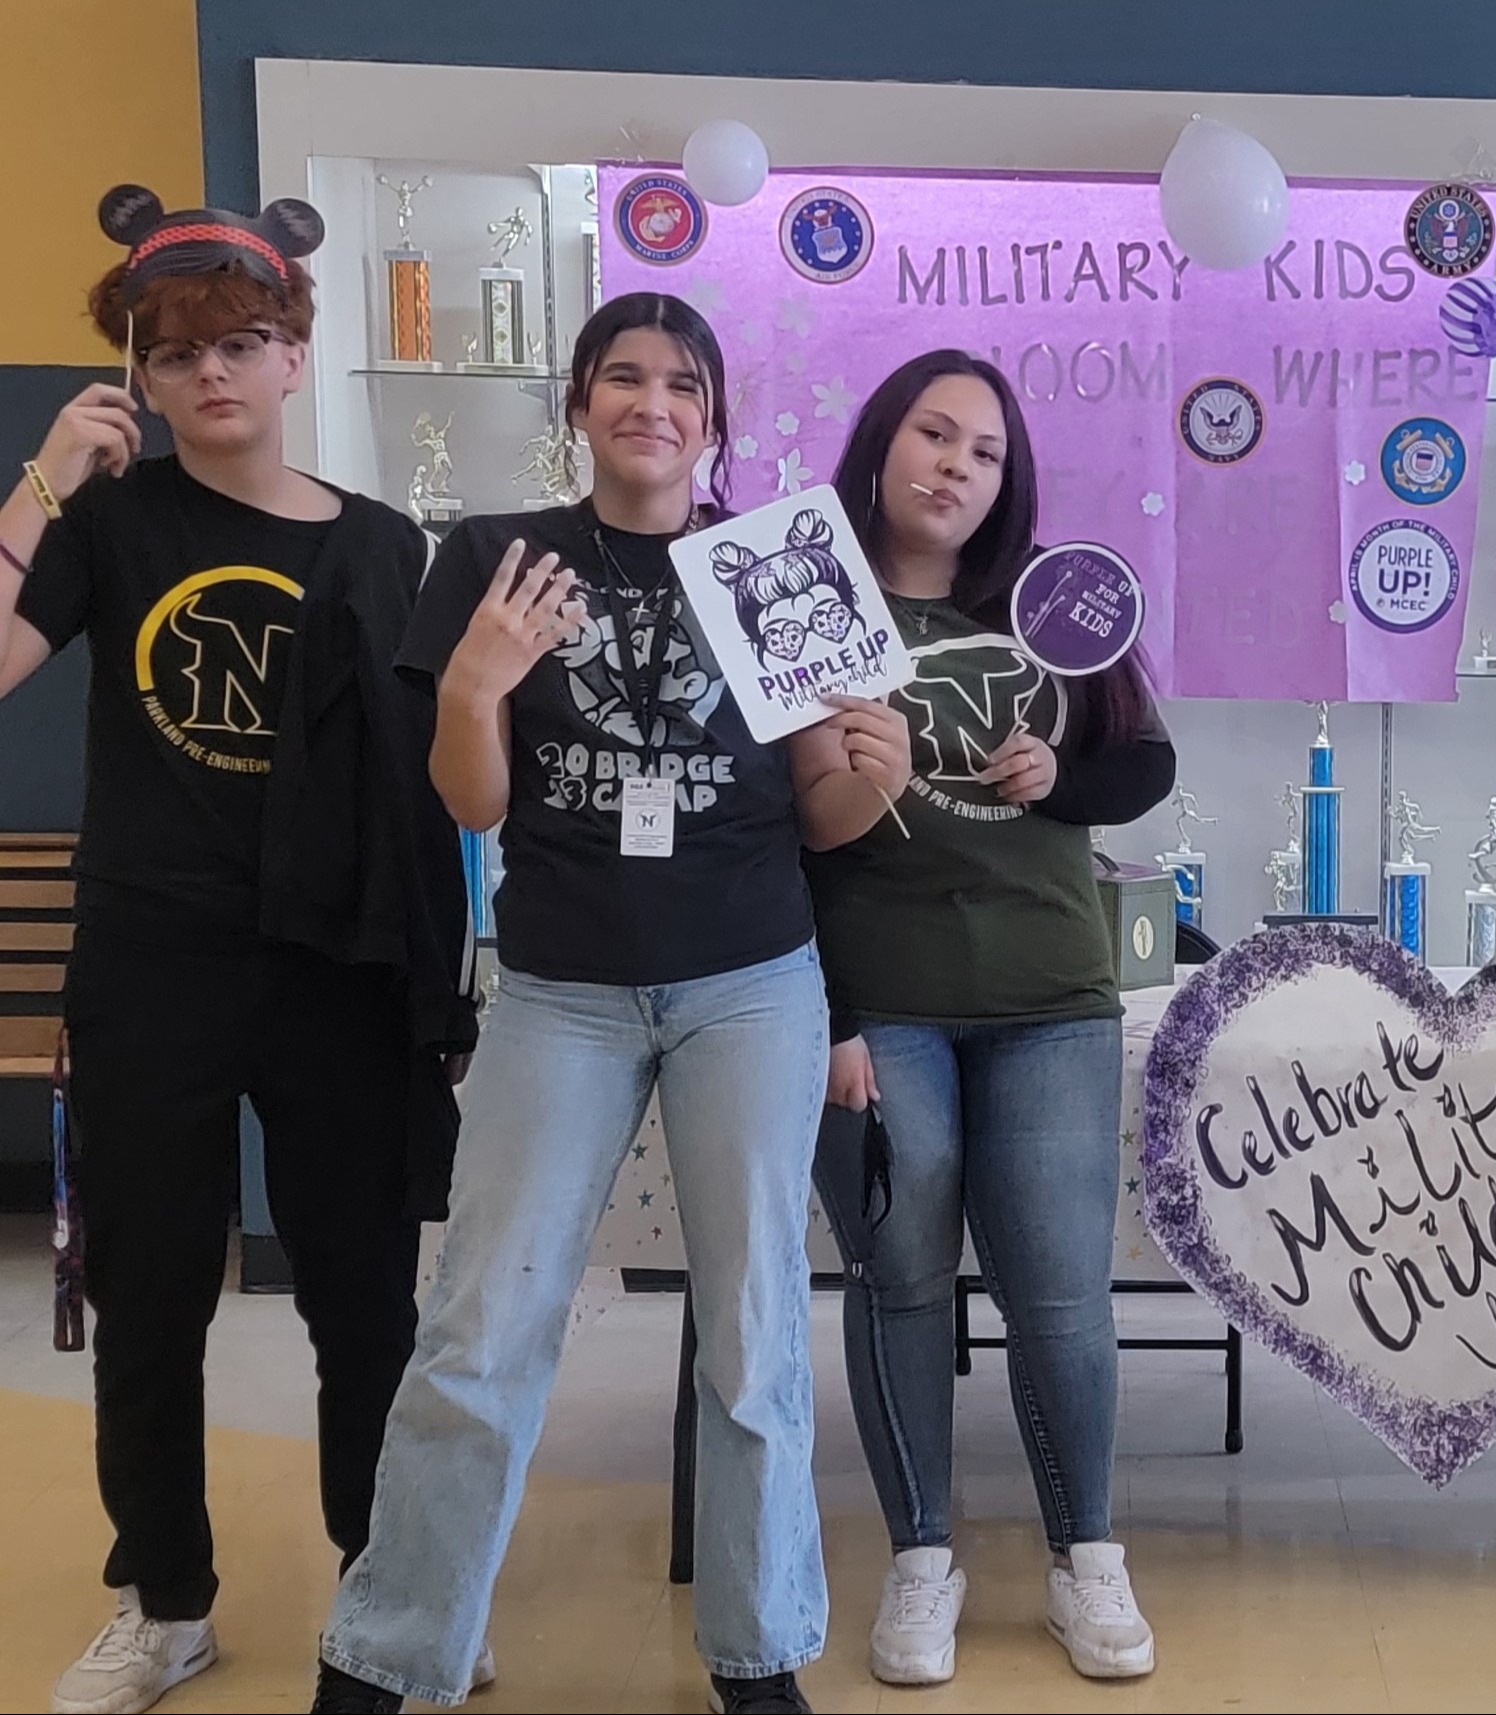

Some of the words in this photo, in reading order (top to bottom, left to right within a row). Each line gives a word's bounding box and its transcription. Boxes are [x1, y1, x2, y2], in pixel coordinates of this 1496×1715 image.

[657, 179, 688, 197] STATES
[1410, 187, 1448, 219] UNITED
[1450, 187, 1487, 217] STATES
[634, 243, 667, 260] MARINE
[671, 239, 695, 258] CORPS
[897, 239, 1190, 305] MILITARY
[1263, 239, 1417, 302] KIDS
[1430, 259, 1472, 276] ARMY
[1271, 343, 1478, 410] WHERE
[1063, 551, 1117, 586] PURPLE
[1360, 523, 1390, 548] MONTH
[1391, 521, 1405, 530] OF
[1408, 520, 1426, 532] THE
[1448, 568, 1459, 600] CHILD
[1376, 544, 1434, 569] PURPLE
[1094, 582, 1121, 606] FOR
[1378, 567, 1431, 598] UP!
[1067, 600, 1115, 638] KIDS
[1081, 589, 1123, 620] MILITARY
[1389, 598, 1427, 612] MCEC
[757, 646, 858, 702] PURPLE
[856, 628, 890, 662] UP
[141, 695, 186, 746] PARKLAND
[1195, 1020, 1444, 1190] Celebrate
